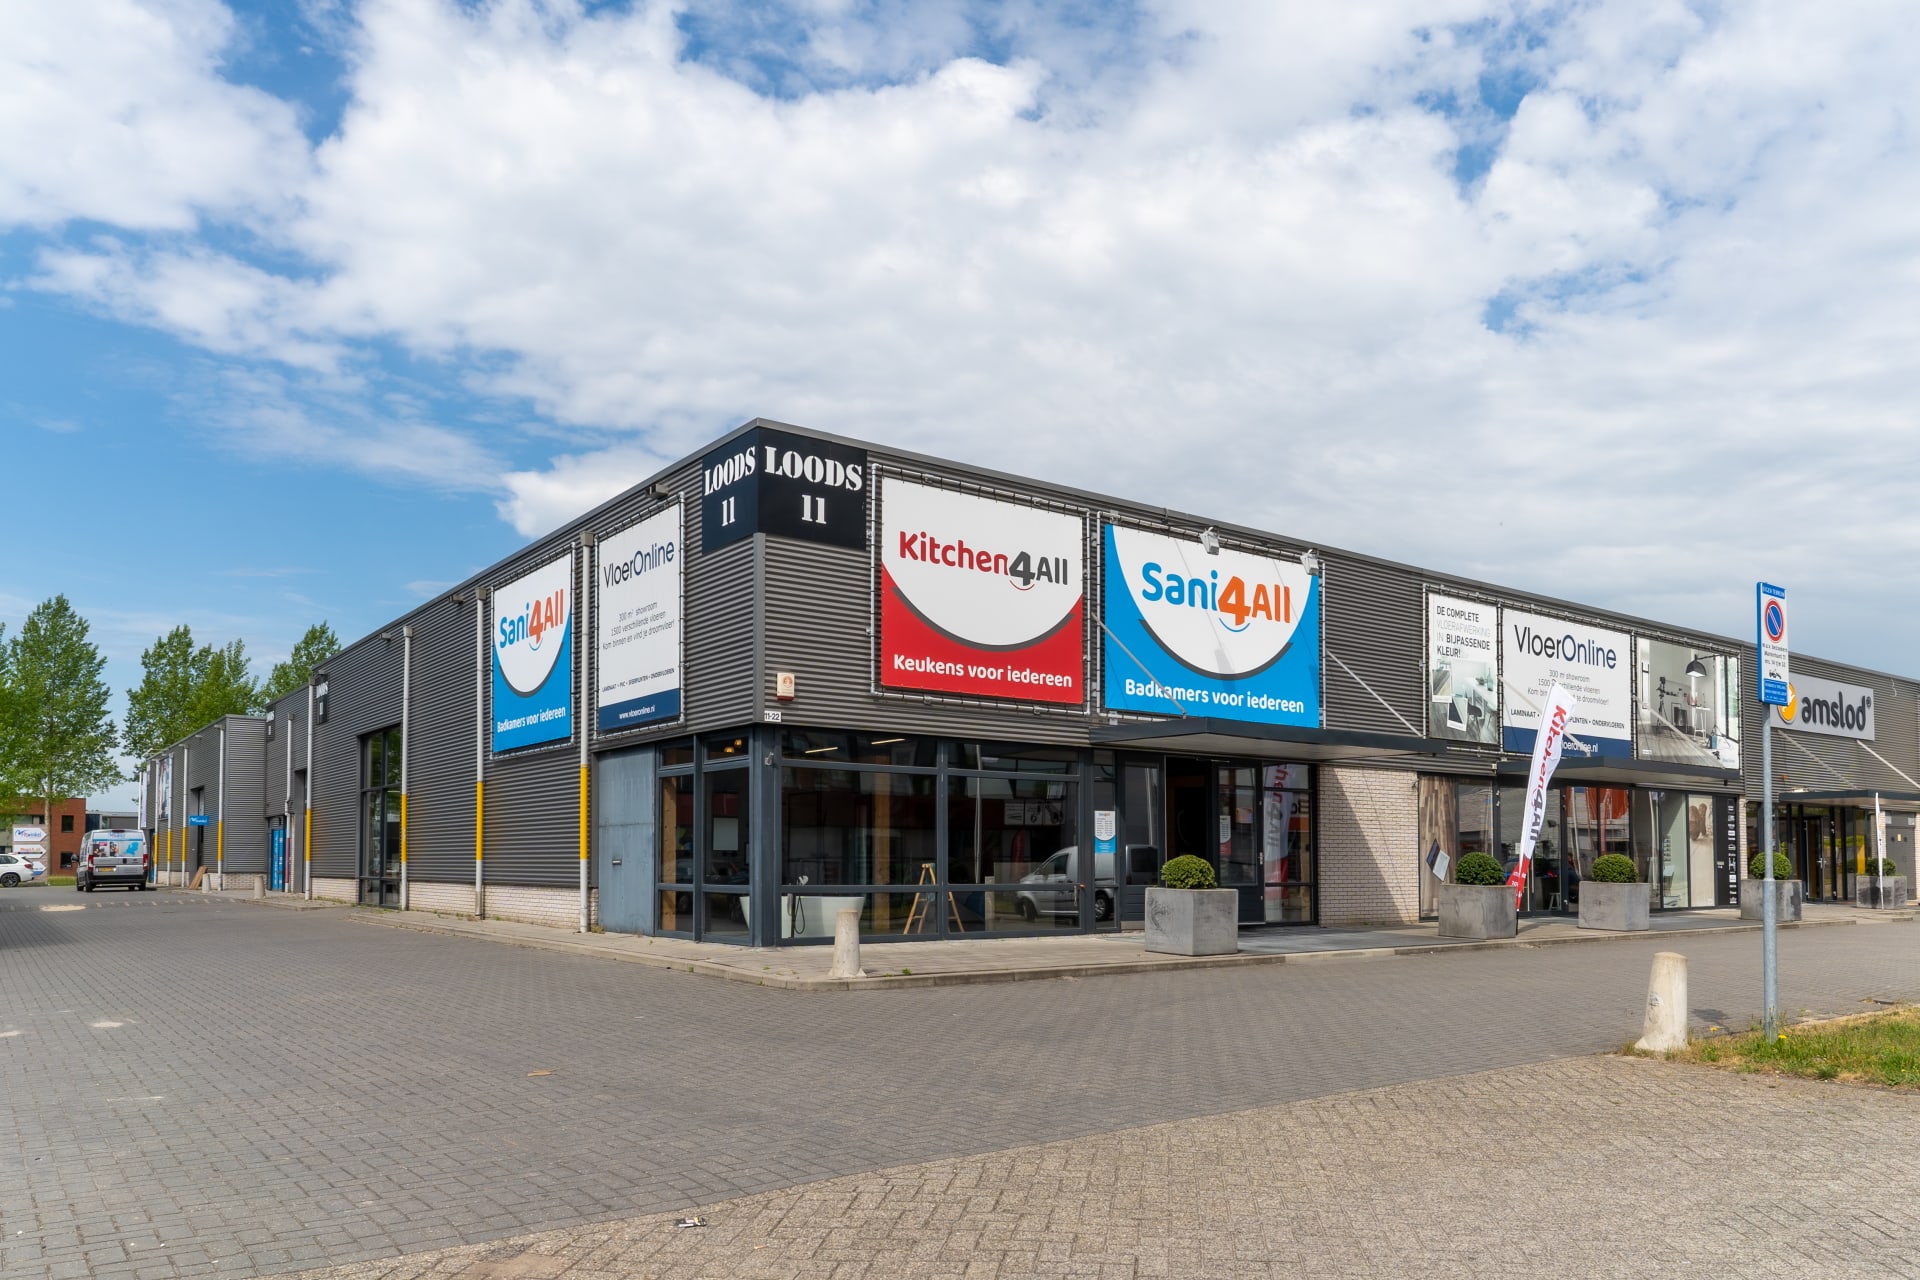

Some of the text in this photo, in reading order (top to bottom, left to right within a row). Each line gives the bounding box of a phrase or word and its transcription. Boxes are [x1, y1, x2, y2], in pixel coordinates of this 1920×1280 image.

[704, 446, 756, 496] LOODS
[764, 445, 863, 491] LOODS
[721, 497, 735, 527] 11
[801, 495, 827, 525] 11
[604, 541, 675, 588] VloerOnline
[899, 531, 1068, 586] Kitchen4All
[1141, 561, 1291, 626] Sani4All
[500, 588, 564, 648] Sani4All
[636, 602, 658, 616] showroom
[650, 611, 666, 622] vloeren
[1437, 606, 1480, 623] DE COMPLETE
[613, 637, 627, 647] binnen
[627, 635, 633, 643] en
[634, 629, 643, 640] vind
[1437, 645, 1461, 658] KLEUR!
[1446, 633, 1491, 650] BIJPASSENDE
[1514, 624, 1617, 669] VloerOnline
[893, 653, 1073, 688] Keukens voor iedereen
[1549, 669, 1559, 678] 300
[1566, 673, 1590, 682] showroom
[1125, 678, 1304, 713] Badkamers voor iedereen
[1528, 687, 1539, 695] Kom
[1538, 678, 1550, 686] 1500
[1583, 686, 1601, 694] vloeren
[497, 706, 566, 733] Badkamers voor iedereen
[765, 712, 780, 720] 11-22
[1510, 708, 1536, 718] LAMINAAT
